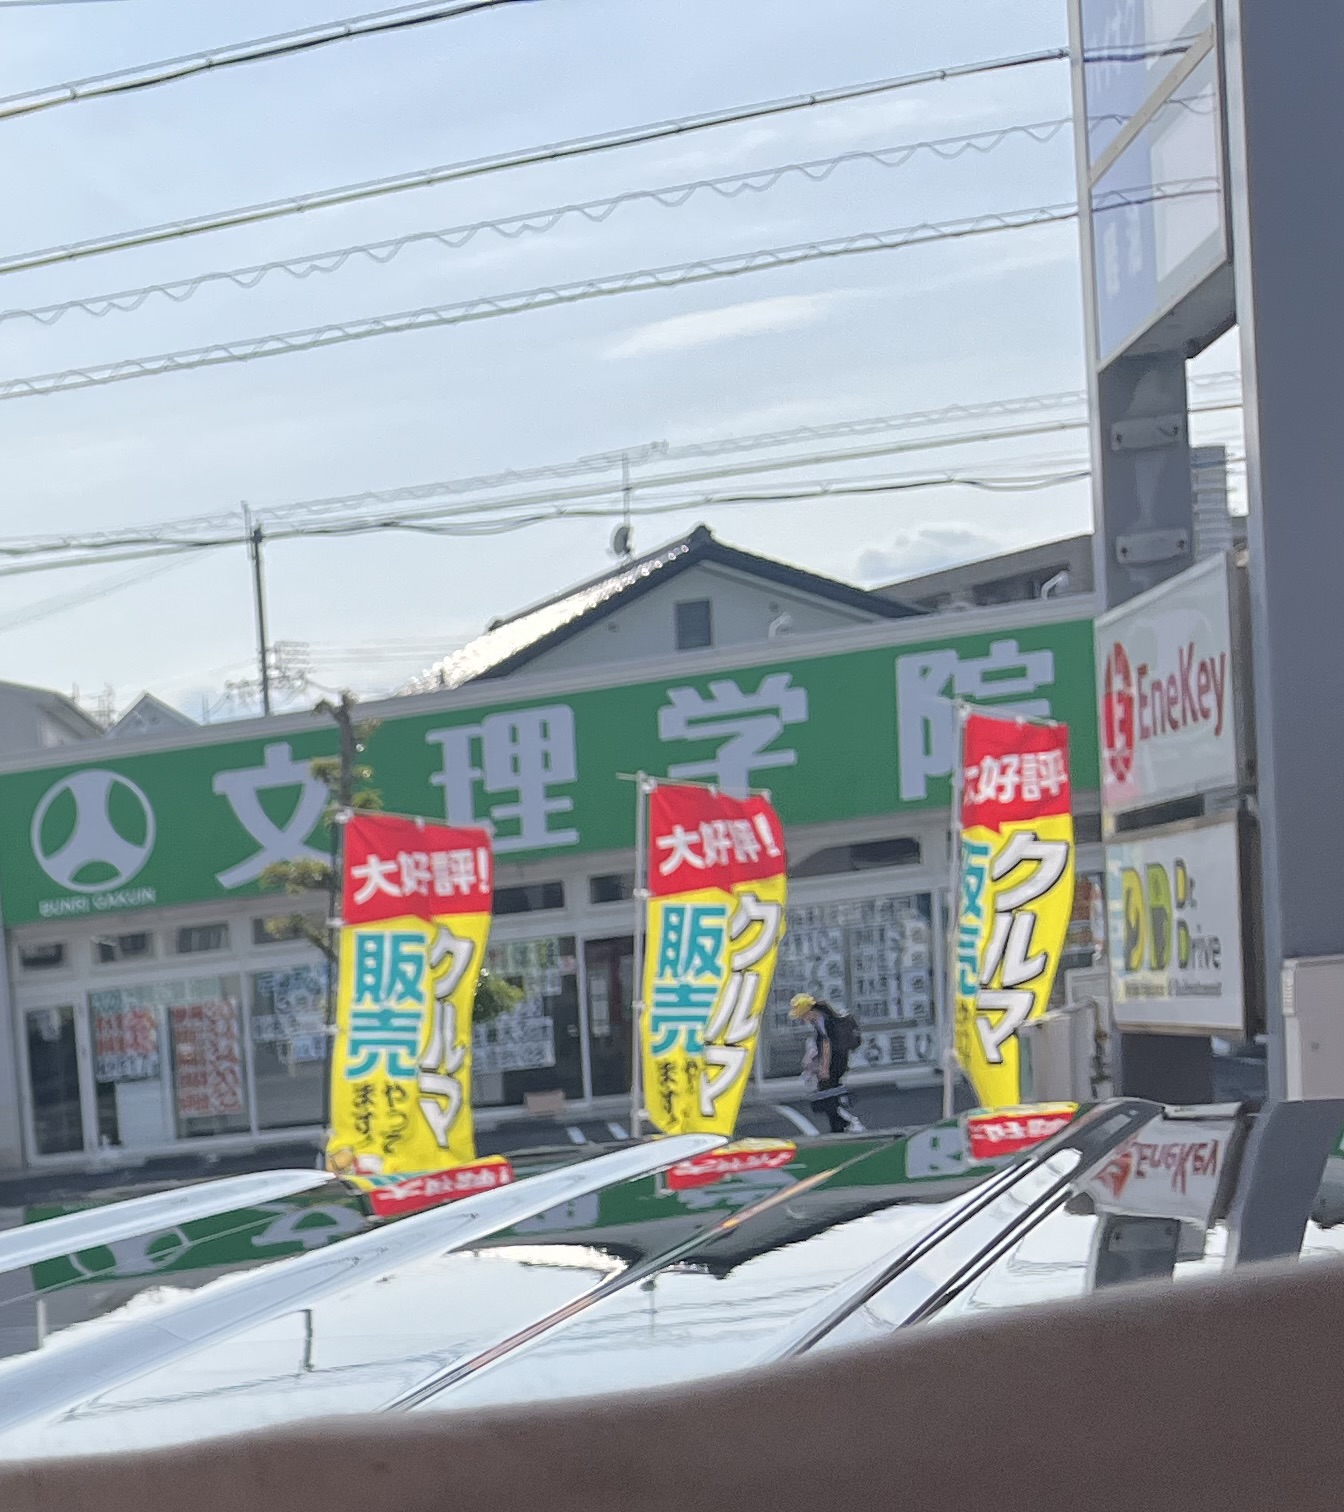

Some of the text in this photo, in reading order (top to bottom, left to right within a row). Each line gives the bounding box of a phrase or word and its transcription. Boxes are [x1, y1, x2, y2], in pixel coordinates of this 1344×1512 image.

[1137, 641, 1227, 738] EneKey
[214, 640, 1054, 890] 文理学院
[39, 887, 157, 917] BUNRI GAKUIN
[351, 847, 490, 906] 大好評!
[656, 812, 782, 877] 大好評!
[345, 930, 428, 1080] 販売
[650, 902, 728, 1058] 販売
[698, 891, 782, 1119] クルマ
[976, 831, 1070, 1065] クルマ
[1178, 918, 1222, 970] Drive
[416, 923, 475, 1150] クルマ
